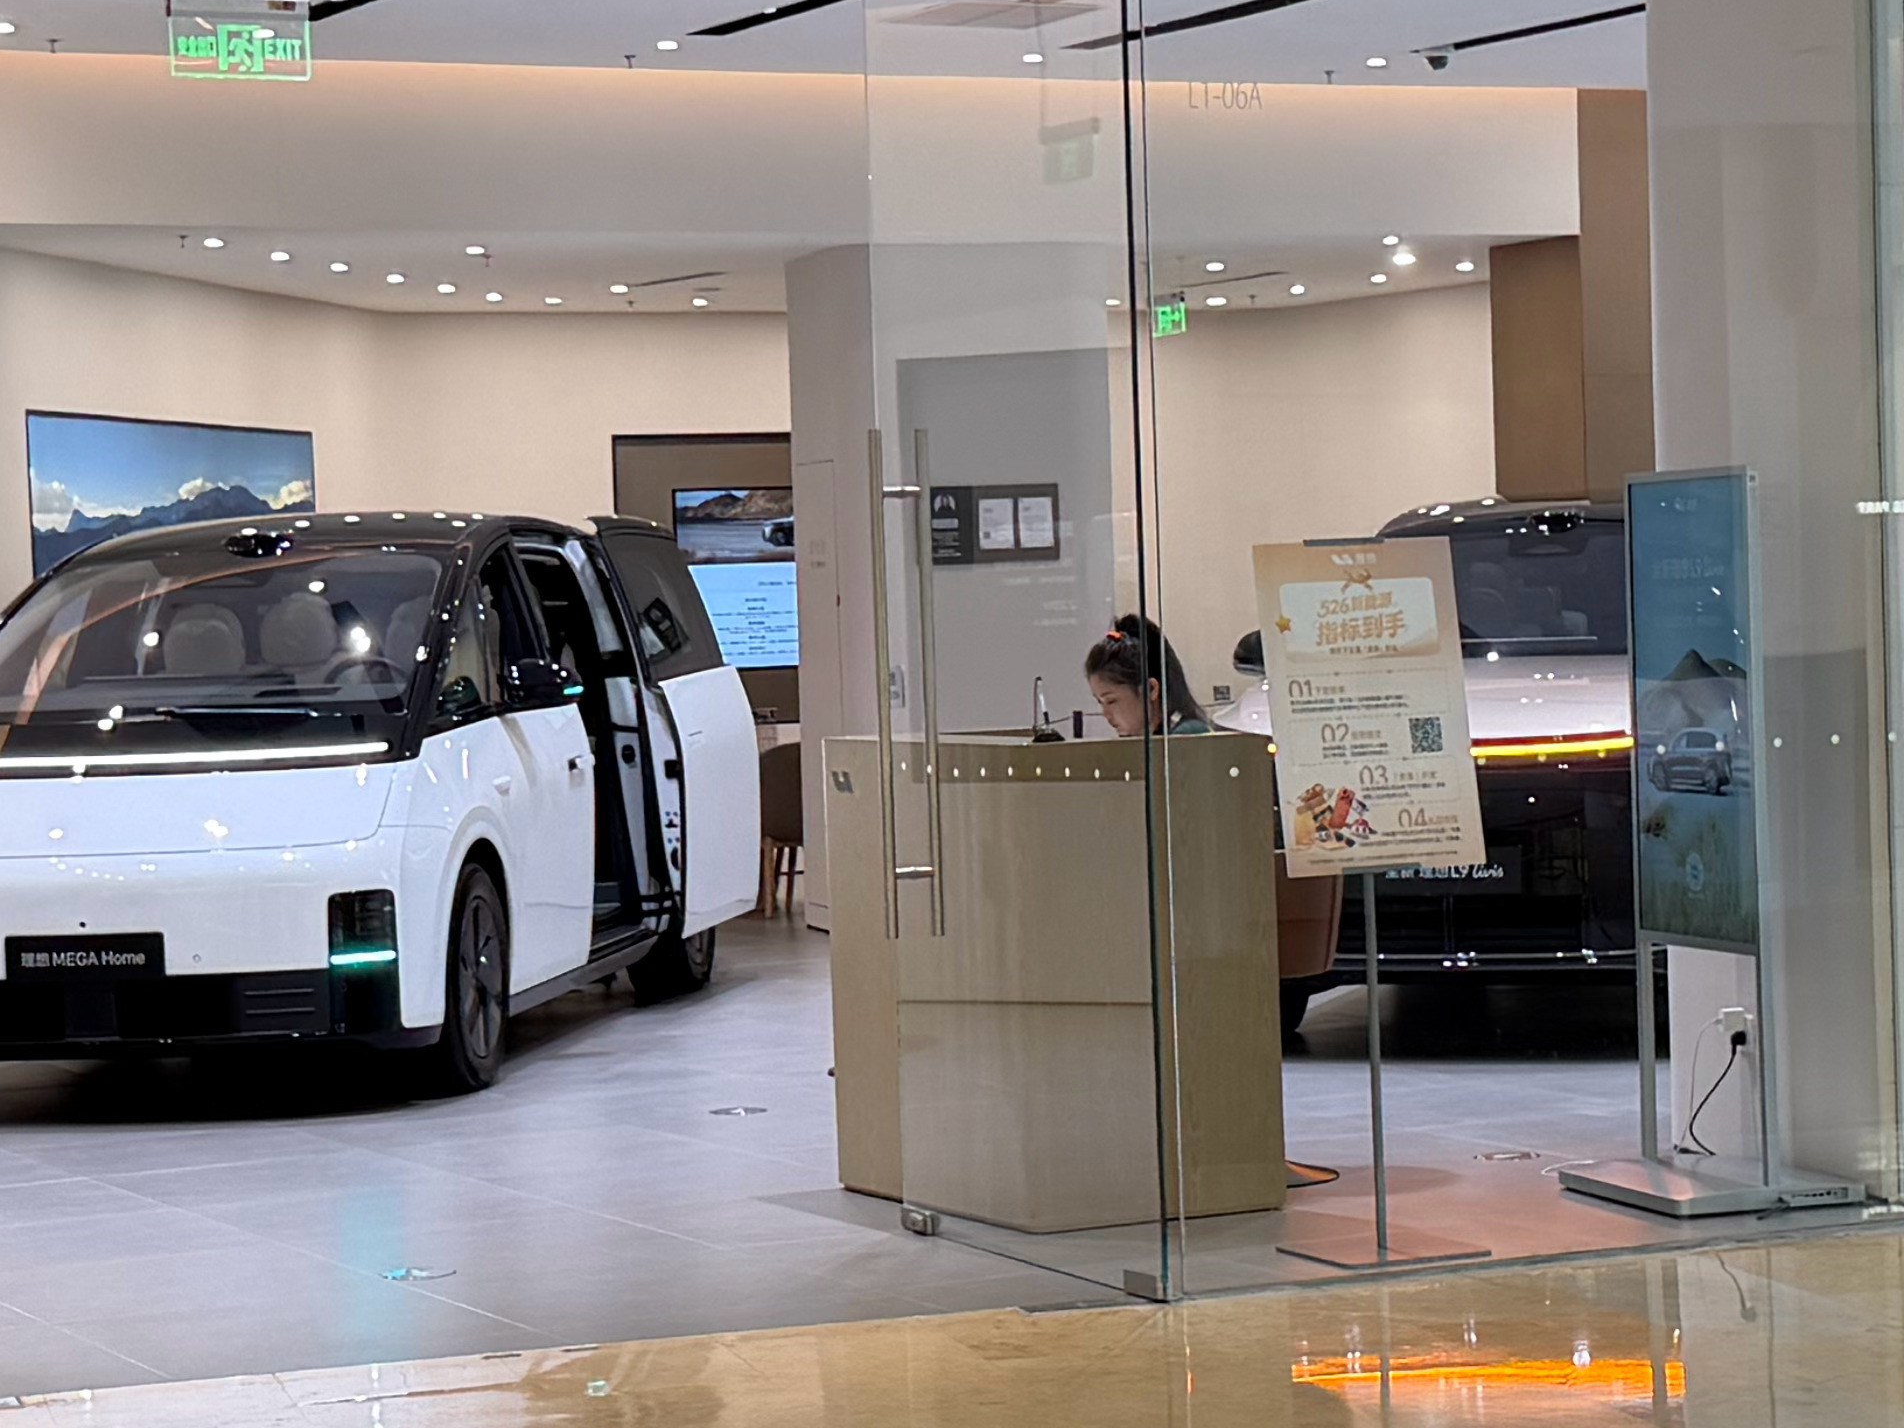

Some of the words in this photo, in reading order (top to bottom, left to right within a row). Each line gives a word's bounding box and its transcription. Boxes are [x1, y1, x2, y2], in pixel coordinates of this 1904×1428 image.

[265, 38, 302, 60] EXIT
[1314, 609, 1407, 647] 指标到手
[52, 951, 99, 967] MEGA
[101, 950, 146, 966] Home
